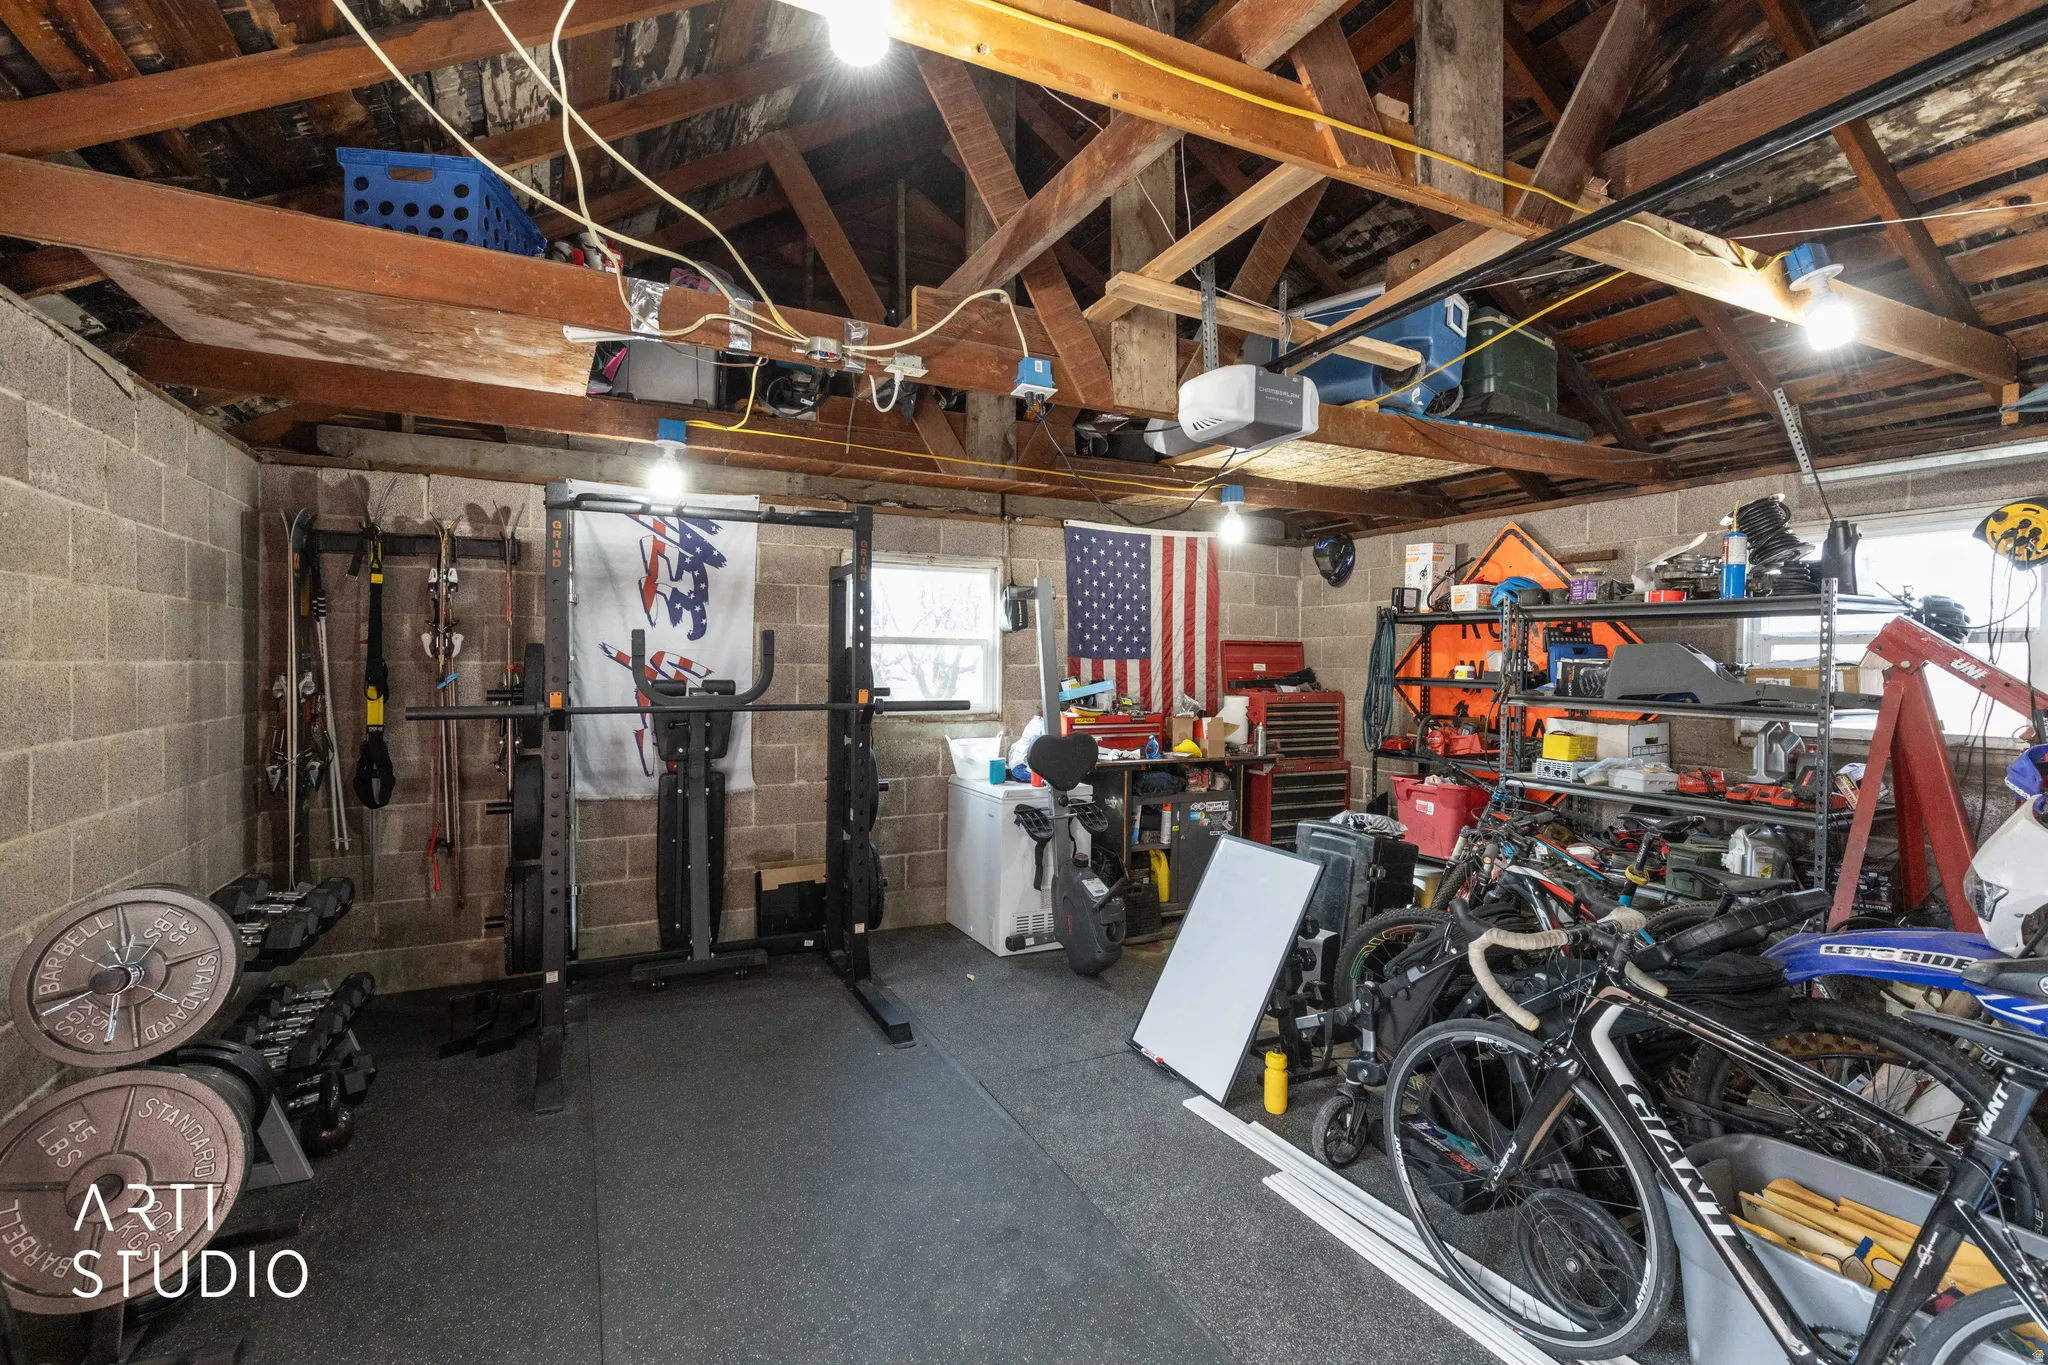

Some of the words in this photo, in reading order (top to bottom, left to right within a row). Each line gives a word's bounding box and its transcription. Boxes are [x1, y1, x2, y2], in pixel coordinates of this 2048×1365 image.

[1258, 386, 1300, 399] CHAMBERLAIN
[552, 520, 562, 568] GRIND
[860, 540, 868, 581] GRIND
[143, 908, 185, 940] LBS
[169, 919, 198, 946] 35
[38, 915, 114, 997] BARBELL
[55, 998, 95, 1037] KGS
[144, 954, 218, 1042] STANDARD
[67, 1118, 97, 1143] 45
[1976, 1082, 2009, 1136] IANT
[36, 1126, 83, 1169] LBS
[138, 1097, 216, 1179] STANDARD
[1620, 1084, 1737, 1237] GIANT
[0, 1199, 74, 1279] BARBELL
[115, 1218, 163, 1263] KGS
